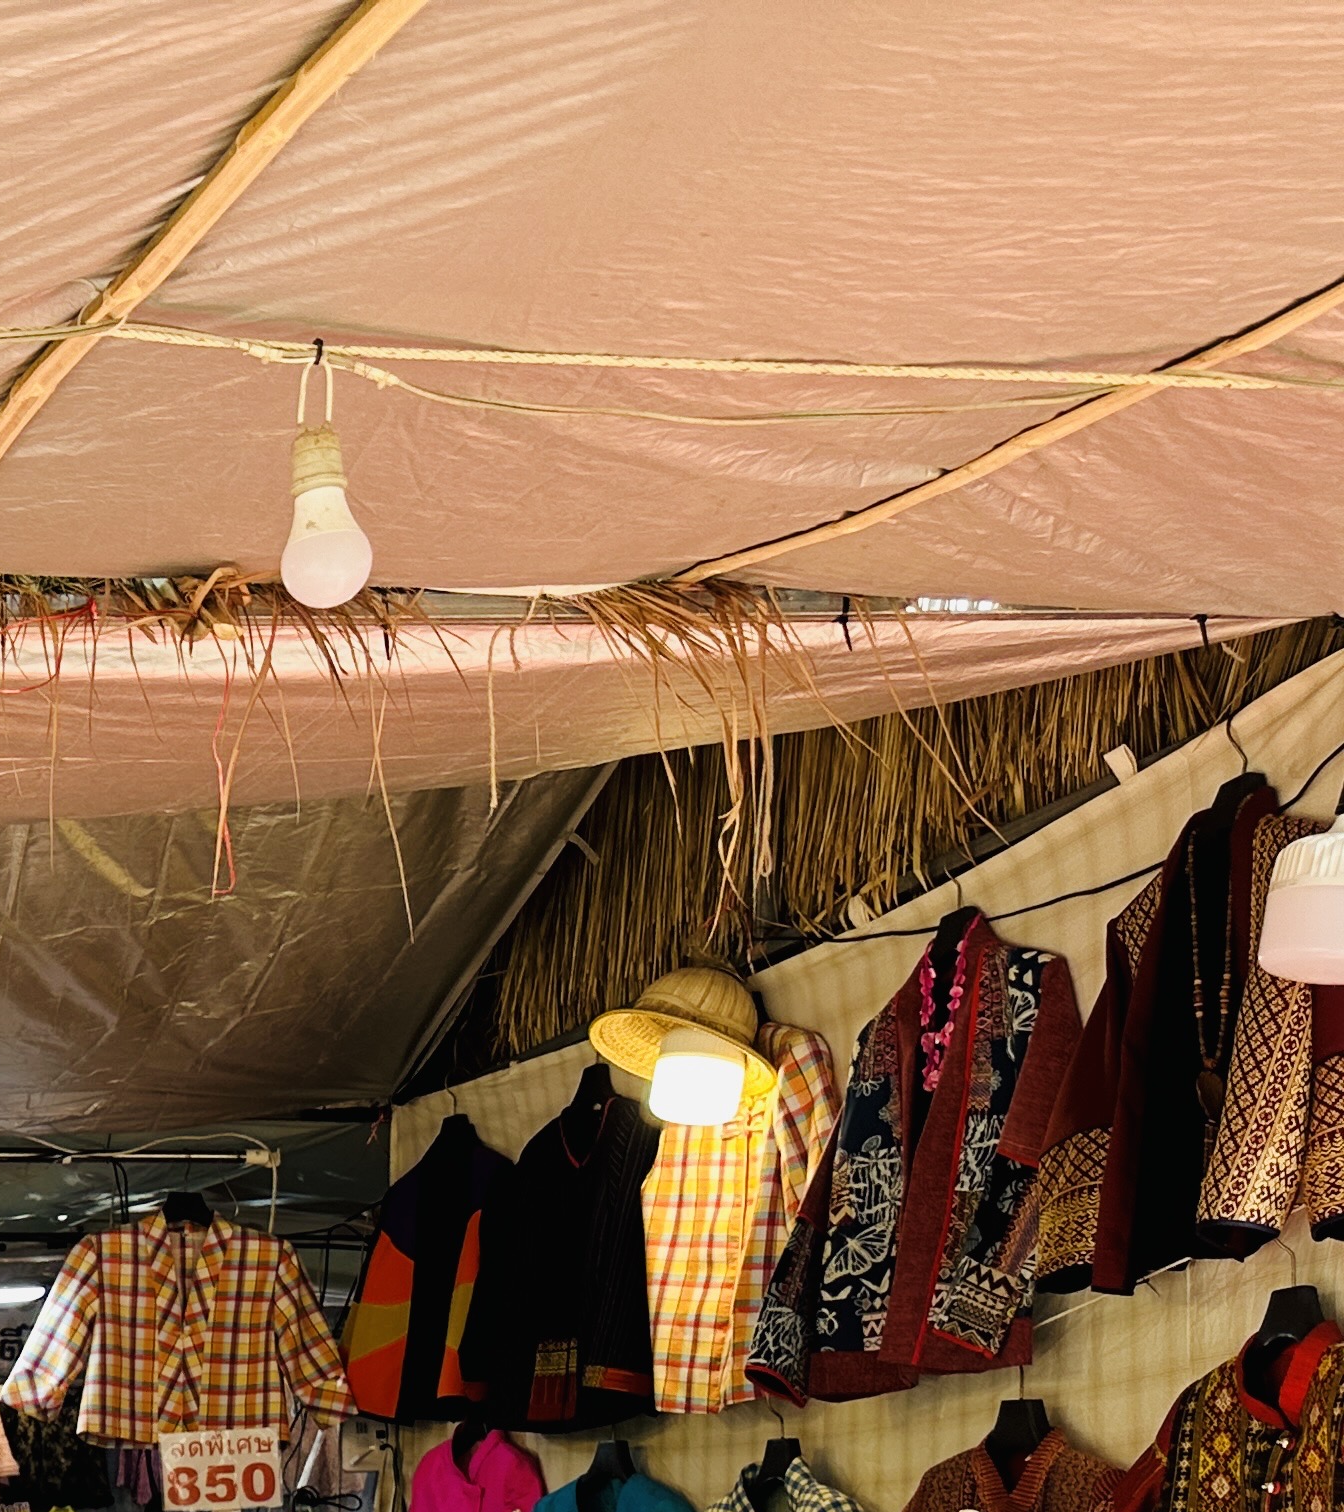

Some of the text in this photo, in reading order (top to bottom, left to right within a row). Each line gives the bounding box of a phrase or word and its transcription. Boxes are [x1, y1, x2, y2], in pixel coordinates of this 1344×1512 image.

[170, 1432, 274, 1458] ลดพิเศษ
[167, 1462, 276, 1506] 850
